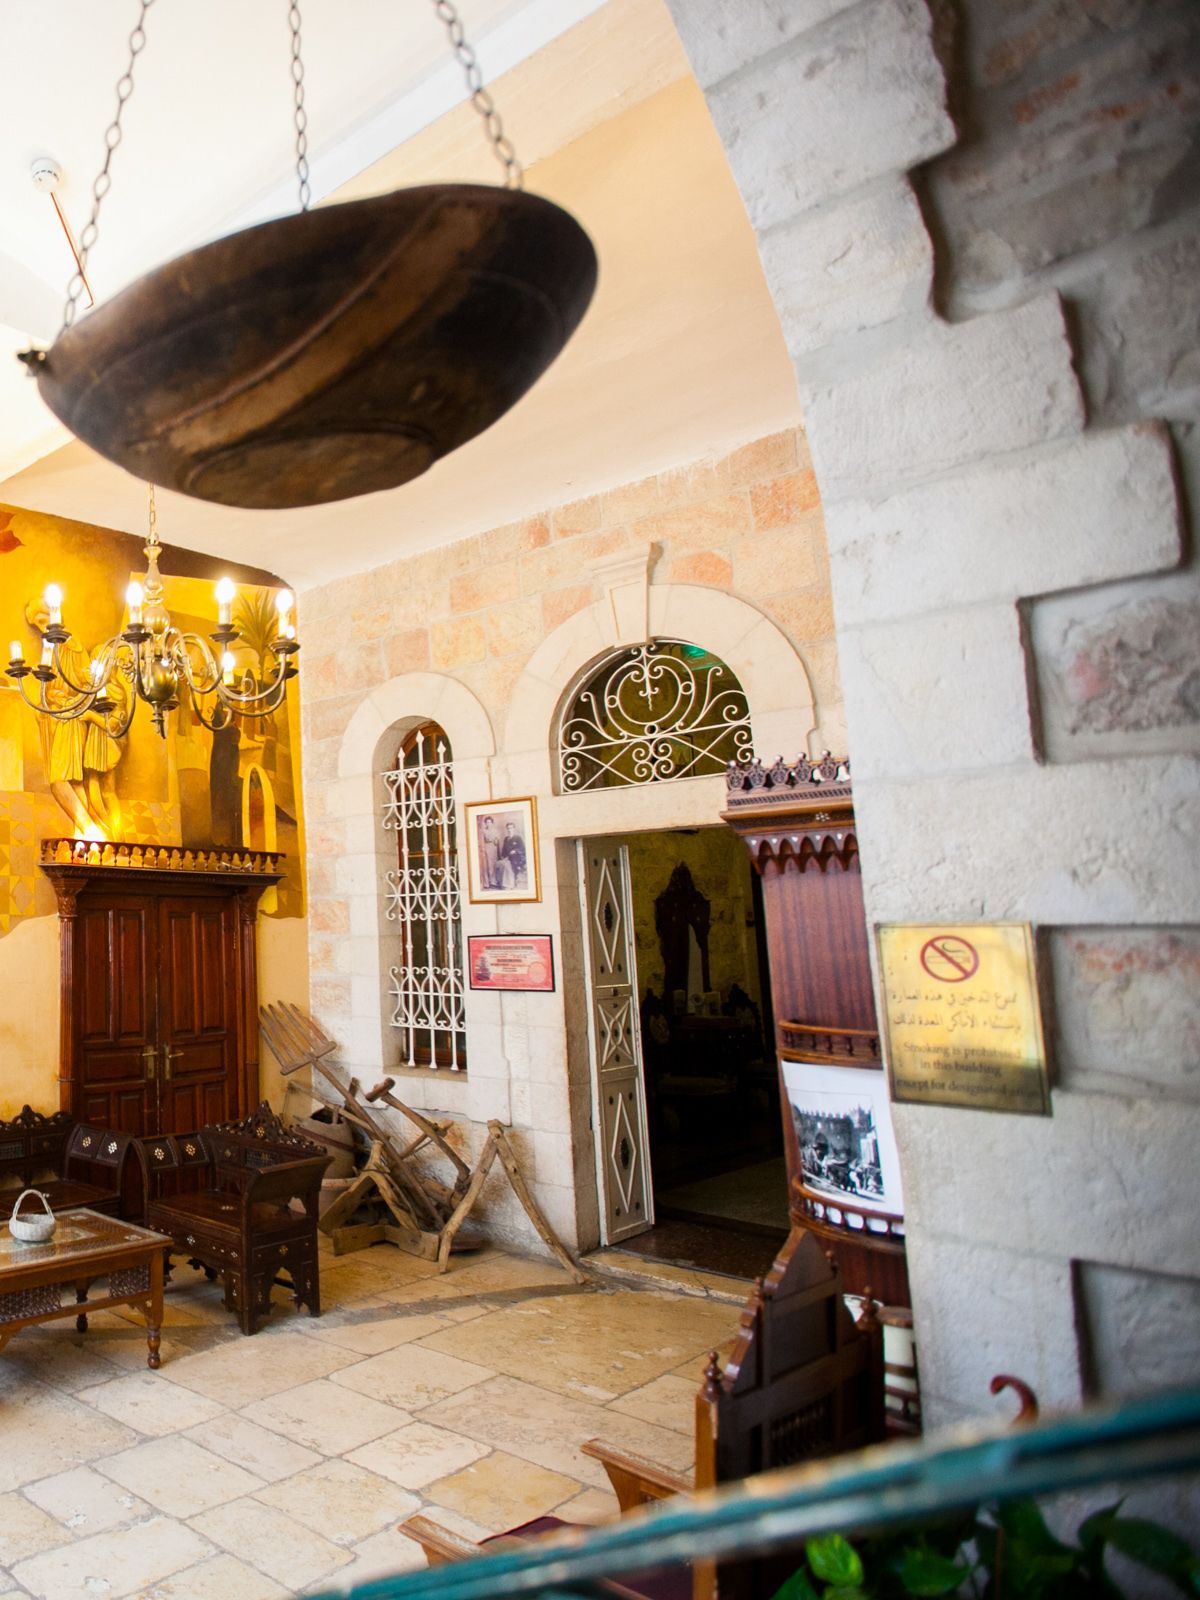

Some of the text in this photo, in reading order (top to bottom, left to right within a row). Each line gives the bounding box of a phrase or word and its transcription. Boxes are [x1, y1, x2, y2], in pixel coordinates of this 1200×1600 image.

[903, 1040, 950, 1059] Smoking
[952, 1046, 962, 1056] is
[920, 1060, 1002, 1078] in this building
[896, 1079, 929, 1093] except
[930, 1078, 946, 1090] for
